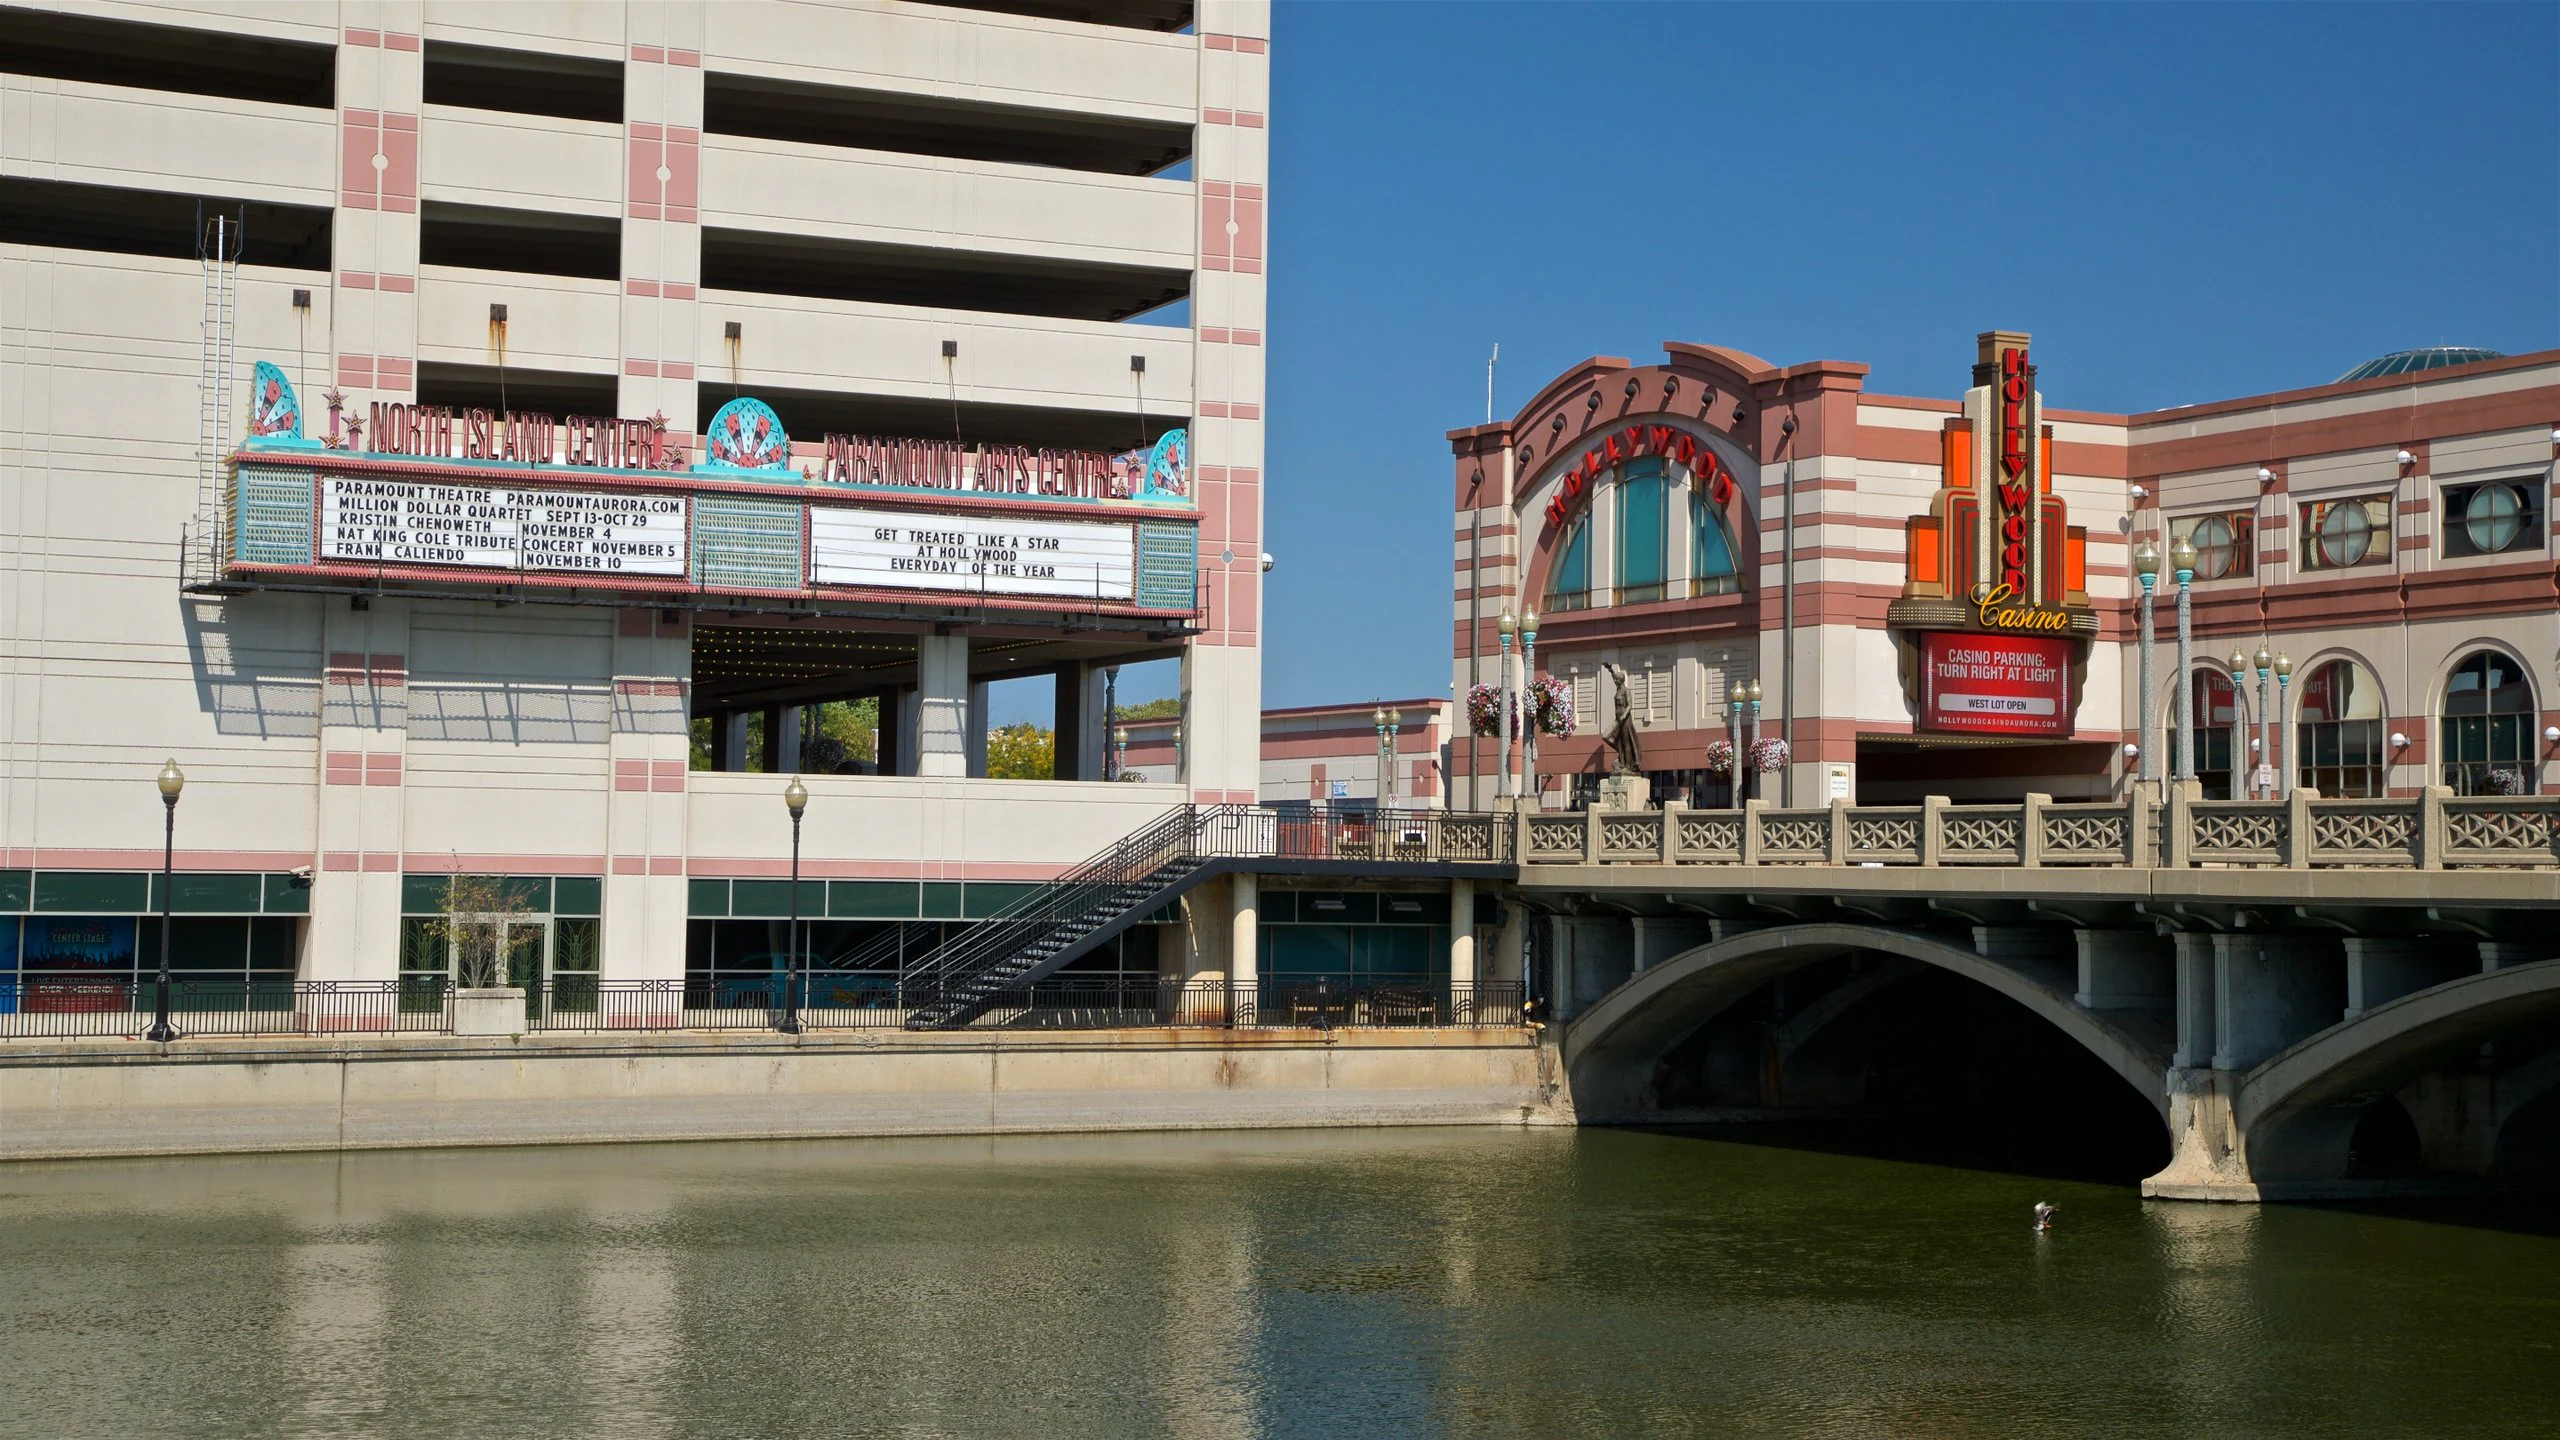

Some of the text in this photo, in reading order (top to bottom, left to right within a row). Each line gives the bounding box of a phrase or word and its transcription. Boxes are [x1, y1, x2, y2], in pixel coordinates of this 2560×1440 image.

[369, 401, 653, 469] NORTH ISLAND CENTER
[822, 432, 1118, 499] PARAMOUNT ARTS CENTRE
[1544, 423, 1734, 529] HOLLYWOOD
[2000, 348, 2032, 595] HOLLYWOOD
[335, 481, 679, 513] PARAMOUNT THEATRE PARAMOUNTAURORA.COM
[339, 497, 647, 527] MILLION DOLLAR QUARTET SEPT 13-OCT 29
[339, 512, 612, 539] KRISTIN CHENOWETH NOVEMBER 4
[337, 527, 675, 557] NAT KING COLE TRIBUTE CONCERT NOVEMBER 5
[875, 528, 1060, 550] GET TREATED LIKE A STAR
[917, 545, 933, 558] AT
[337, 542, 622, 569] FRANK CALIENDO NOVEMBER 10
[891, 558, 1055, 578] EVERYDAY OF THE YEAR
[1970, 583, 2068, 630] Casino
[1948, 648, 2046, 667] CASINO PARKING:
[1937, 663, 2056, 683] TURN RIGHT AT LIGHT
[1968, 698, 2027, 710] WEST LOT OPEN
[1938, 716, 2057, 728] HOLLYWOODCASINOAURORA.COM
[53, 933, 105, 943] CENTER STAGE
[52, 977, 122, 985] ENTERTAINMENT
